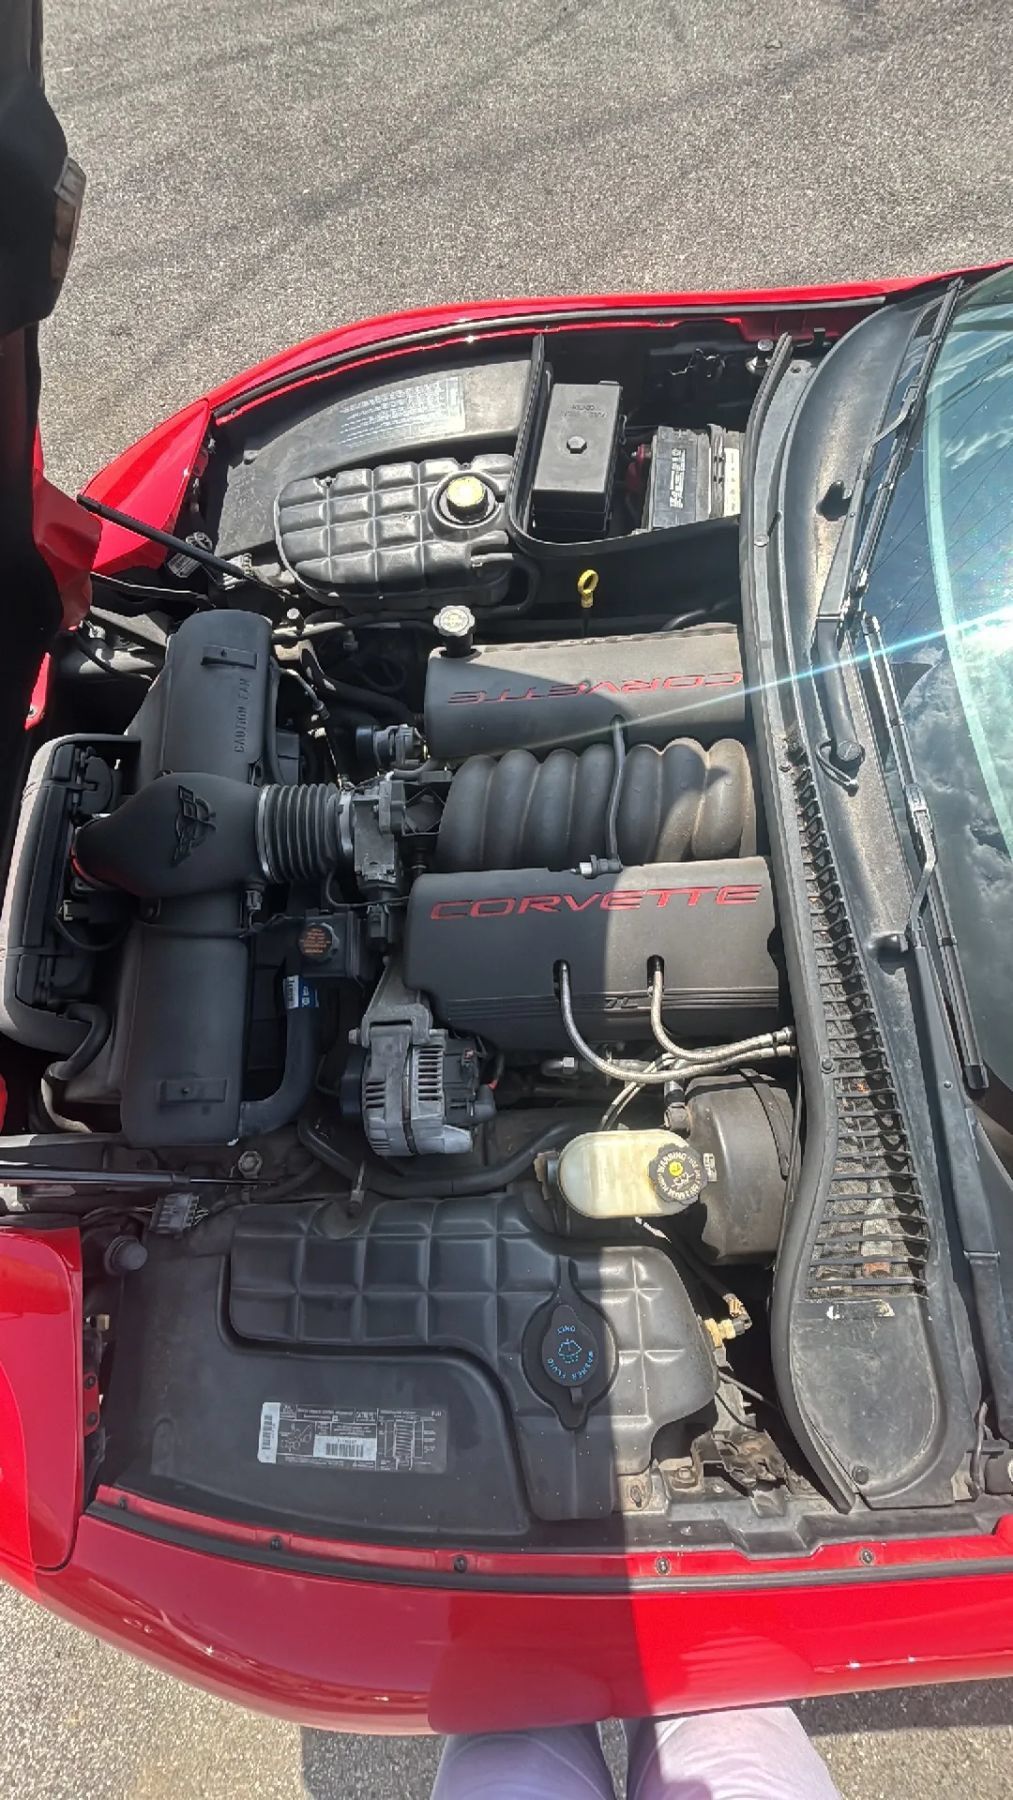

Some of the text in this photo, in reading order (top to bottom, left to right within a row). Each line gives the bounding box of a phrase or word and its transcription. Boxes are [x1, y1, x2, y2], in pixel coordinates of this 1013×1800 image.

[447, 671, 743, 705] CORVETTE
[233, 677, 251, 753] CAUTION FAN
[430, 883, 763, 920] CORVETTE
[547, 1357, 567, 1379] FLUID
